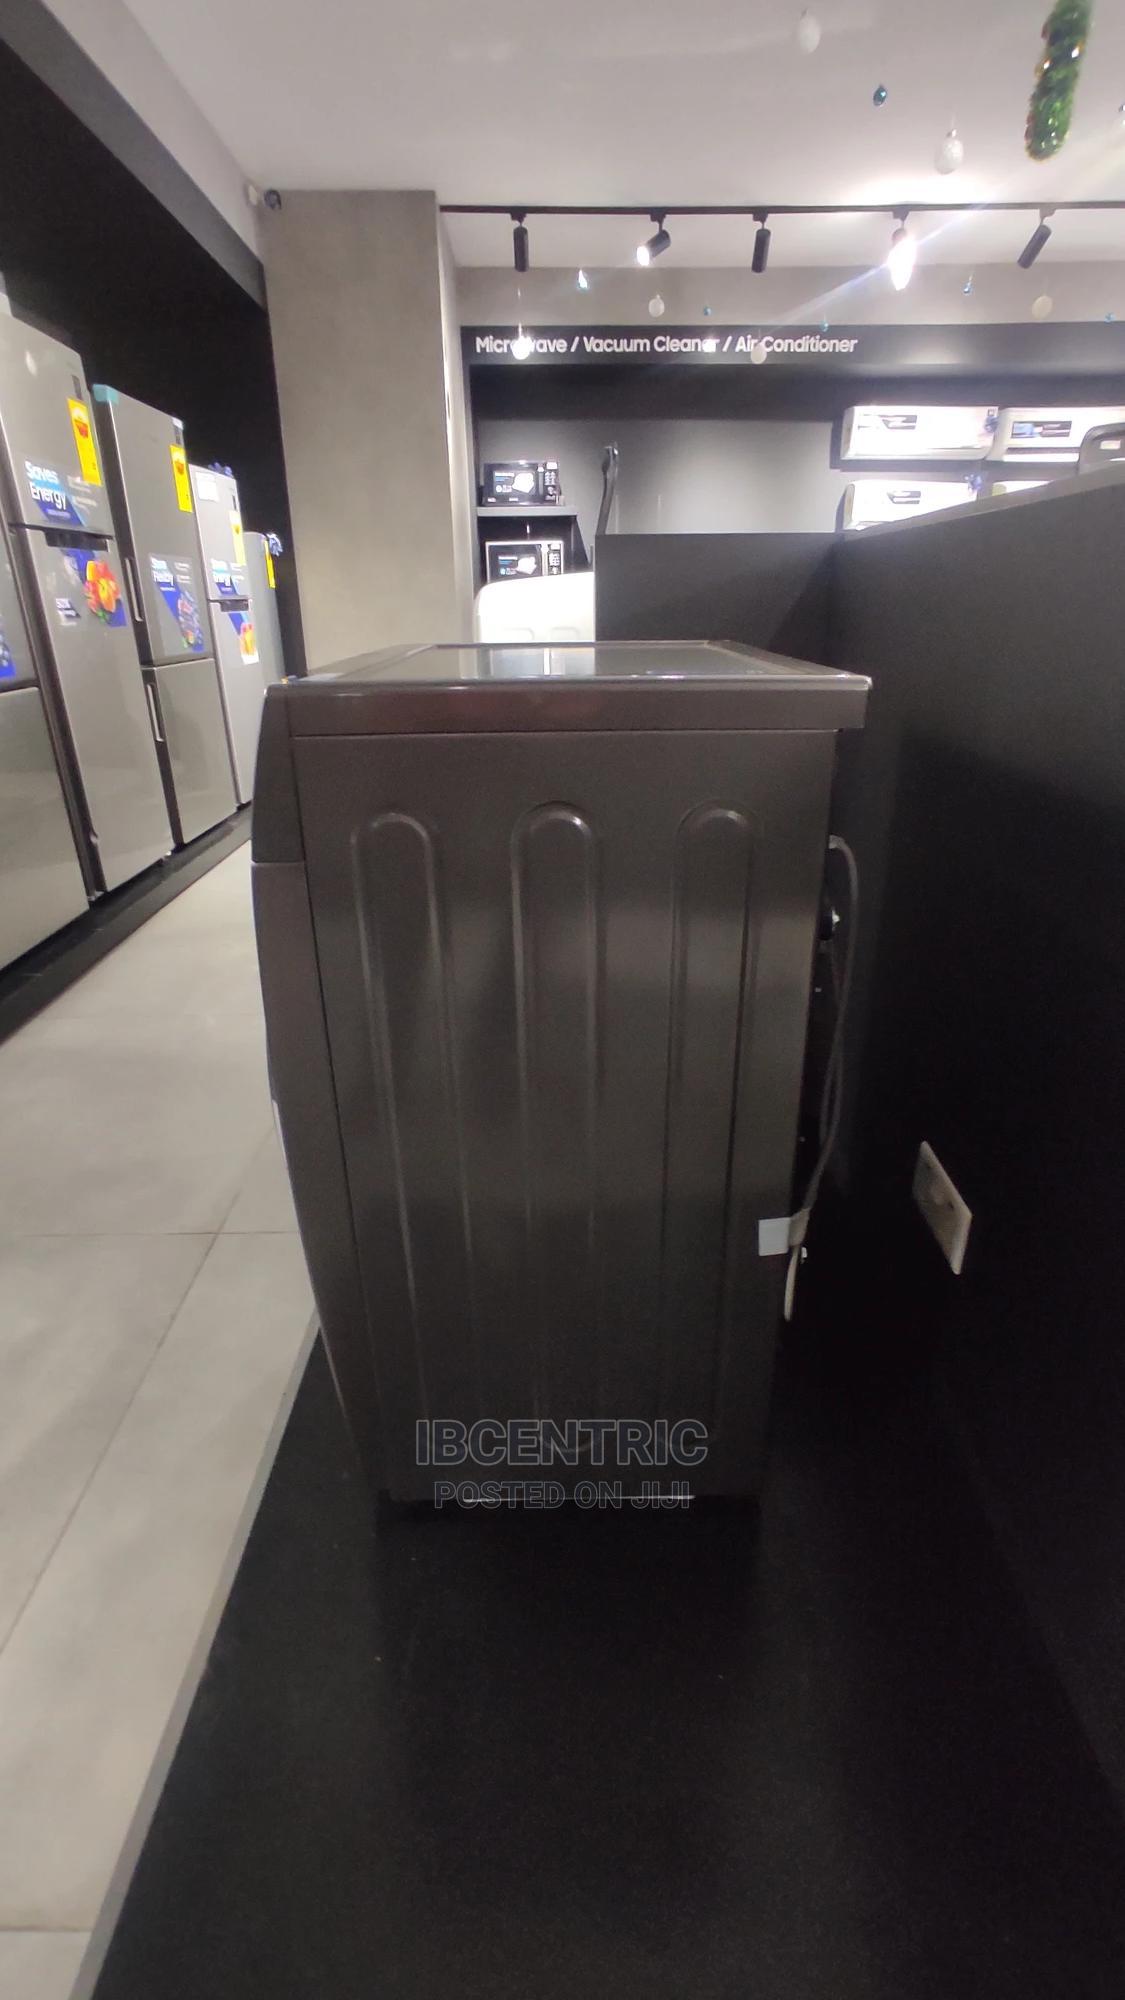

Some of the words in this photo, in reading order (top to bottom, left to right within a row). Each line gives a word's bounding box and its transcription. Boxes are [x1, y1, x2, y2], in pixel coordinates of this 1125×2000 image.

[475, 335, 568, 353] Micrave
[570, 336, 580, 352] /
[583, 335, 650, 353] Vacuum
[722, 335, 732, 352] /
[735, 334, 759, 352] Air
[761, 335, 859, 353] Conditioner
[29, 481, 66, 510] Energy
